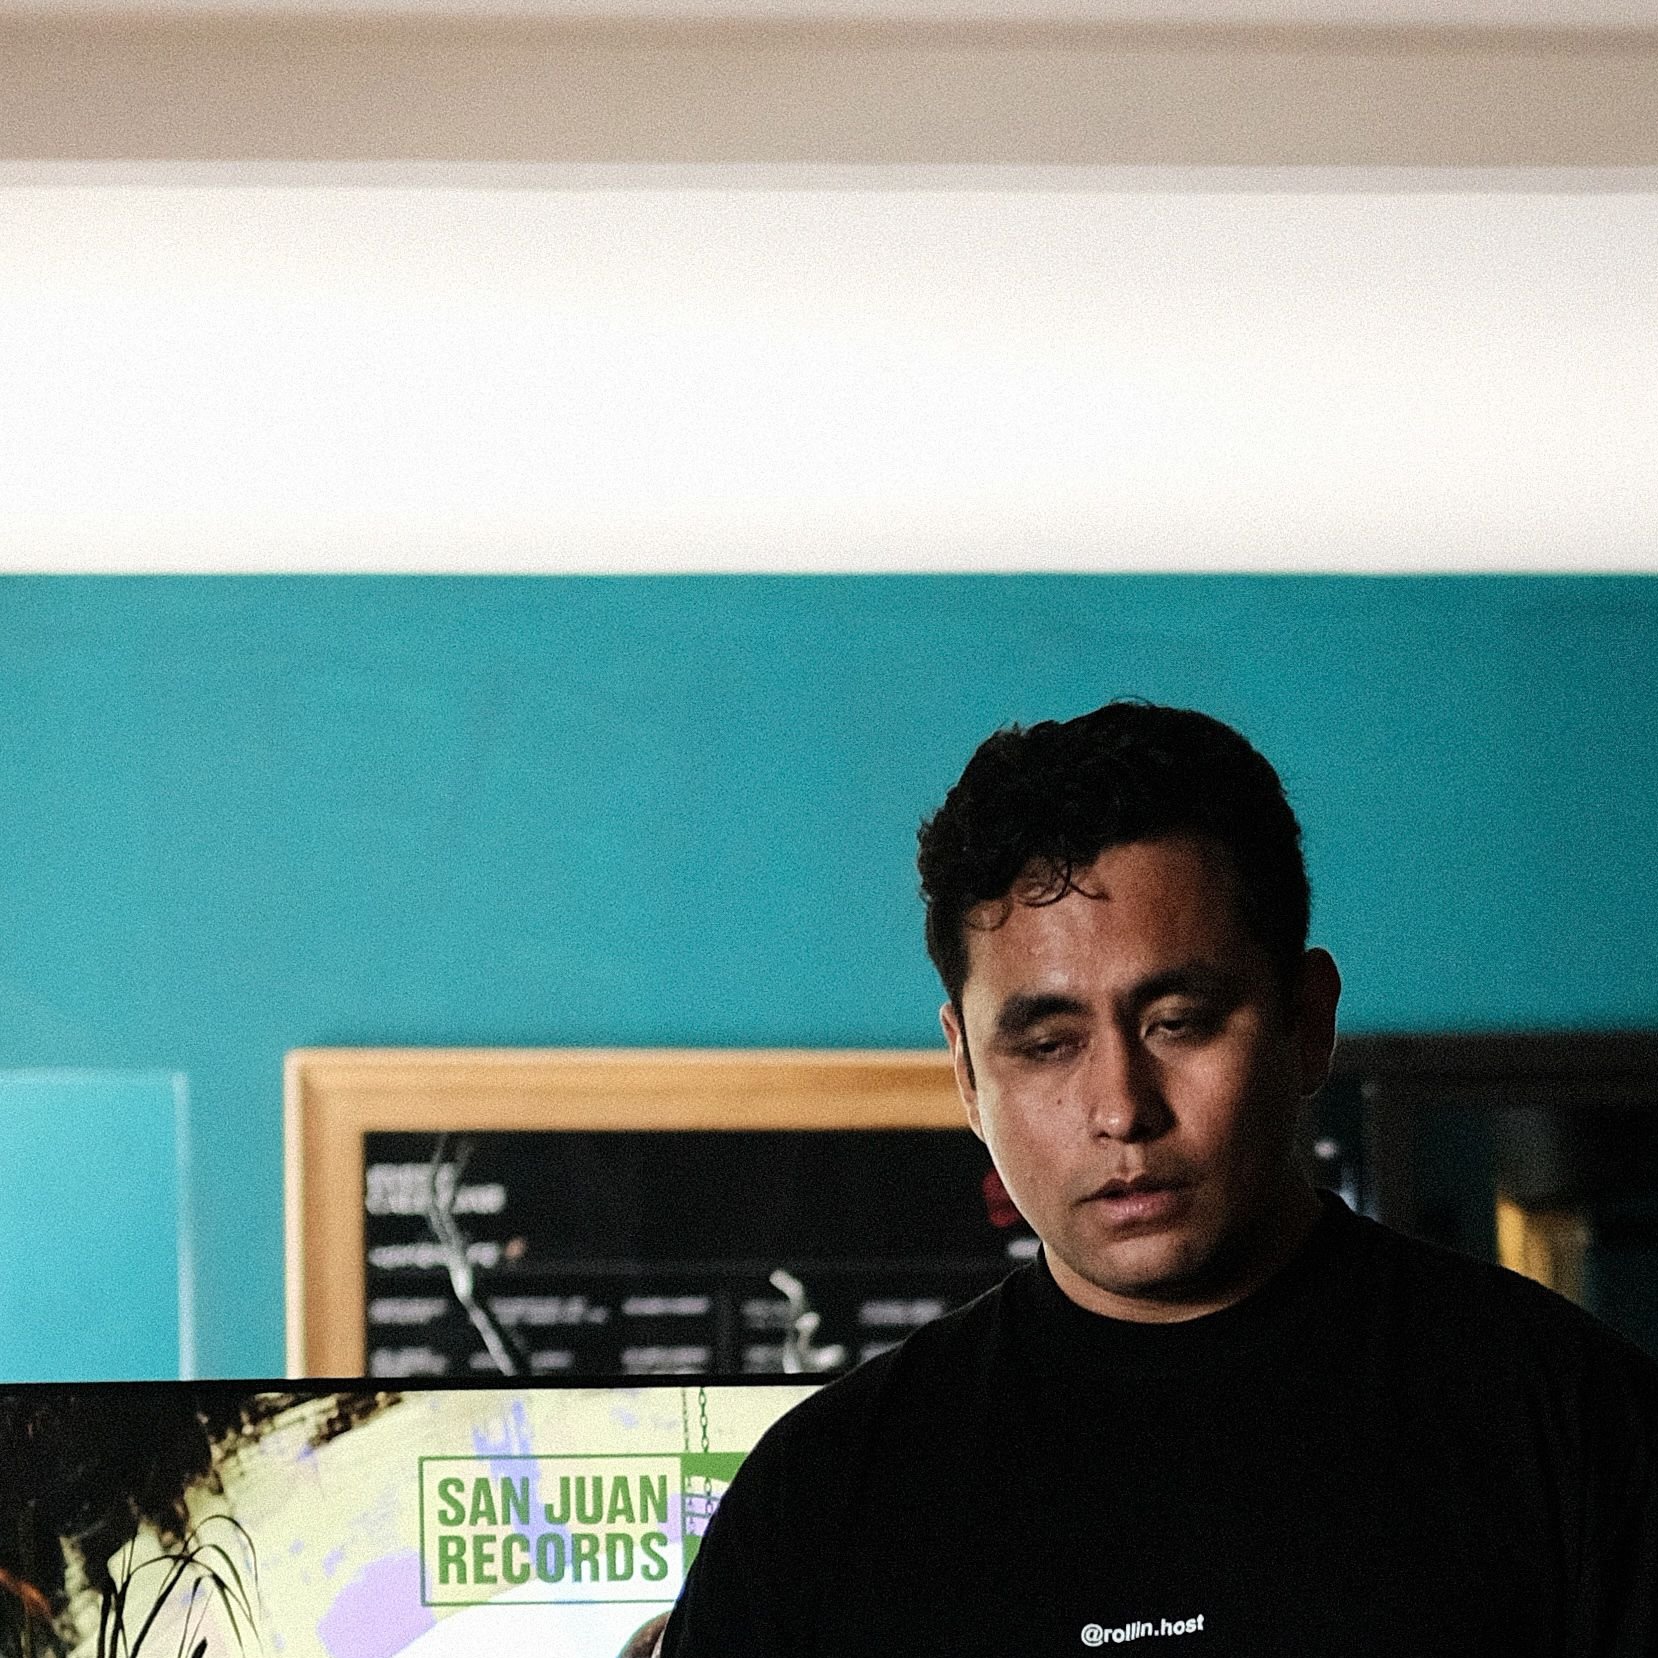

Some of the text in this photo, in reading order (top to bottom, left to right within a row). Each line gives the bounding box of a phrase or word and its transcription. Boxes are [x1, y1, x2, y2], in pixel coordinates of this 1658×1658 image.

[437, 1473, 669, 1527] SAN JUAN
[438, 1530, 669, 1585] RECORDS
